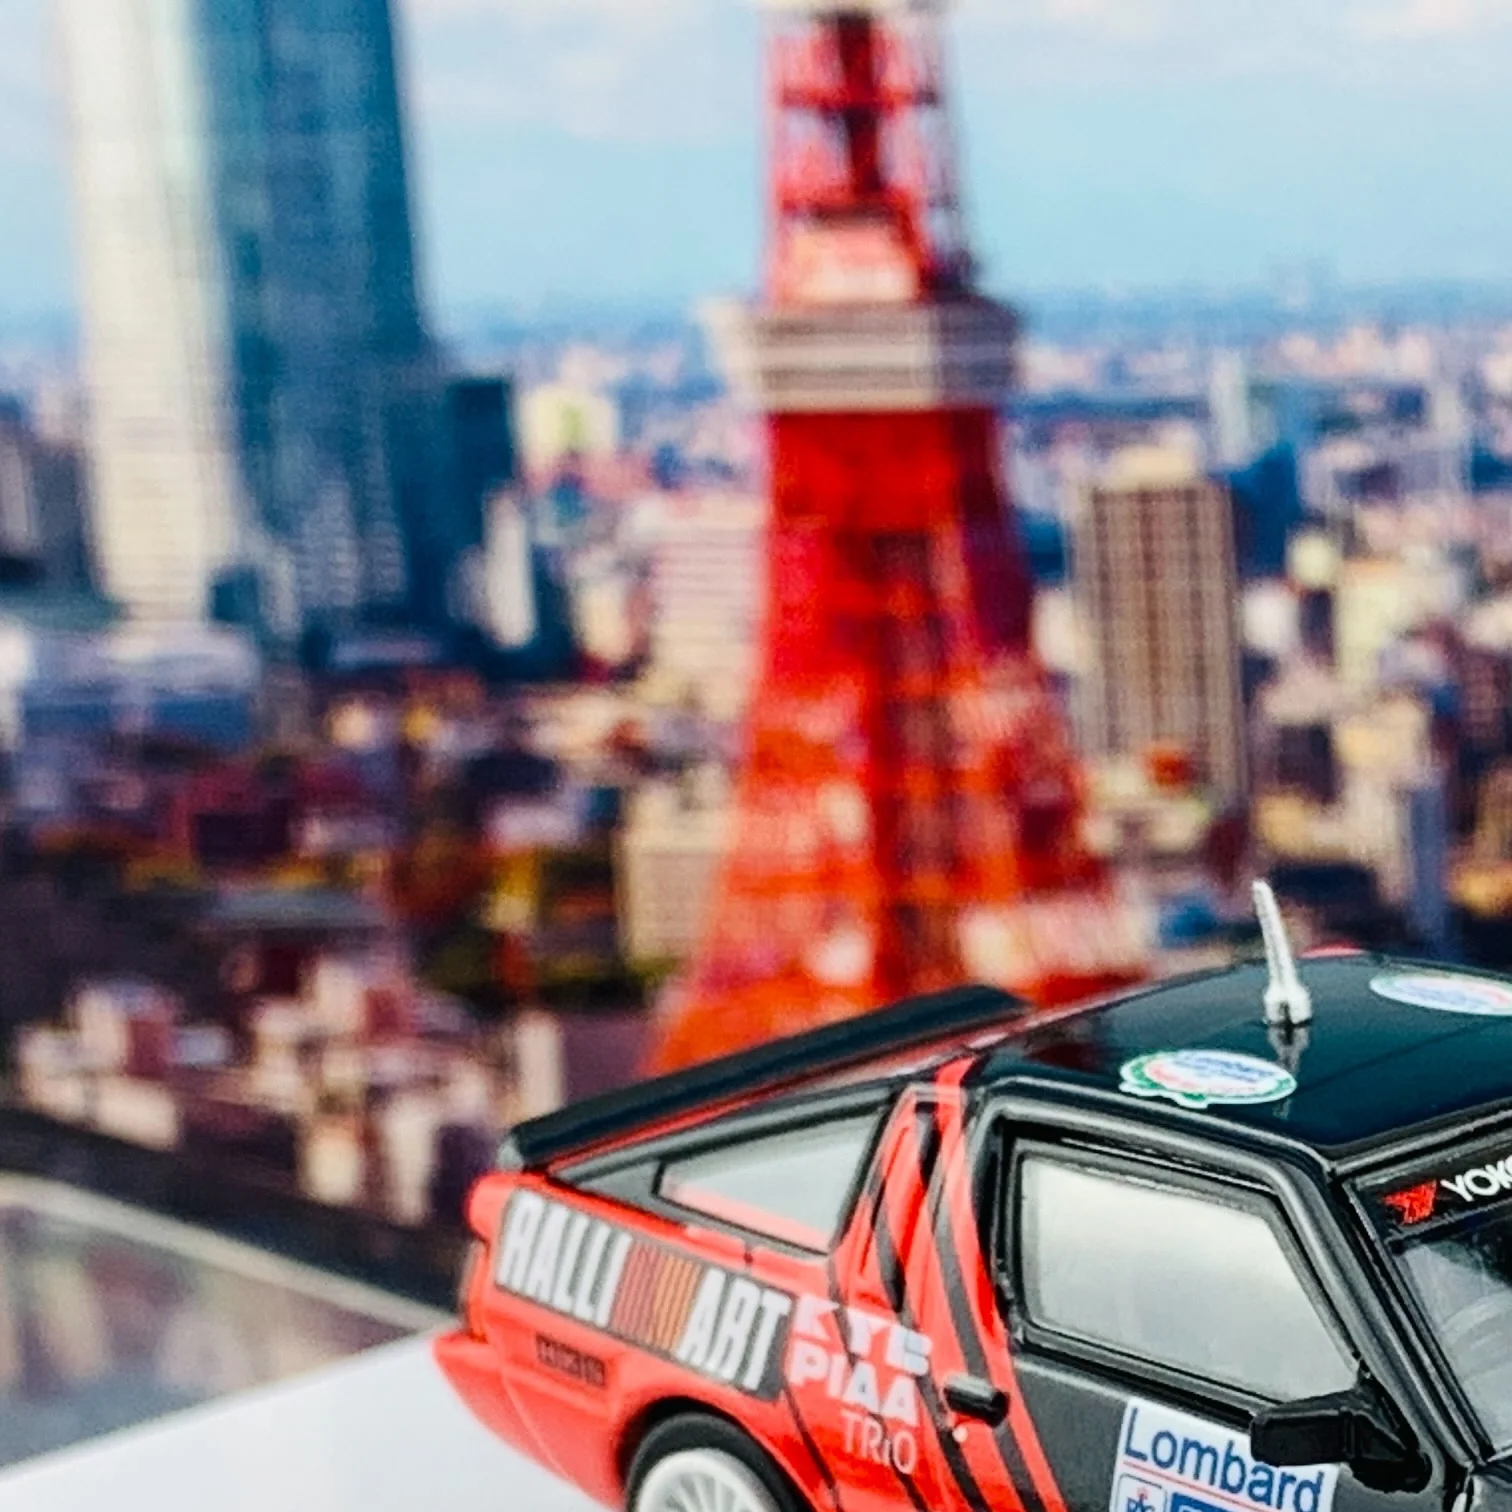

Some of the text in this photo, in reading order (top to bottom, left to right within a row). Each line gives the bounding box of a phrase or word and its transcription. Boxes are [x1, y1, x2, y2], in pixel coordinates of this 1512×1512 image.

[495, 1190, 634, 1328] RALLI
[676, 1267, 791, 1391] ART
[788, 1338, 919, 1428] PIAA
